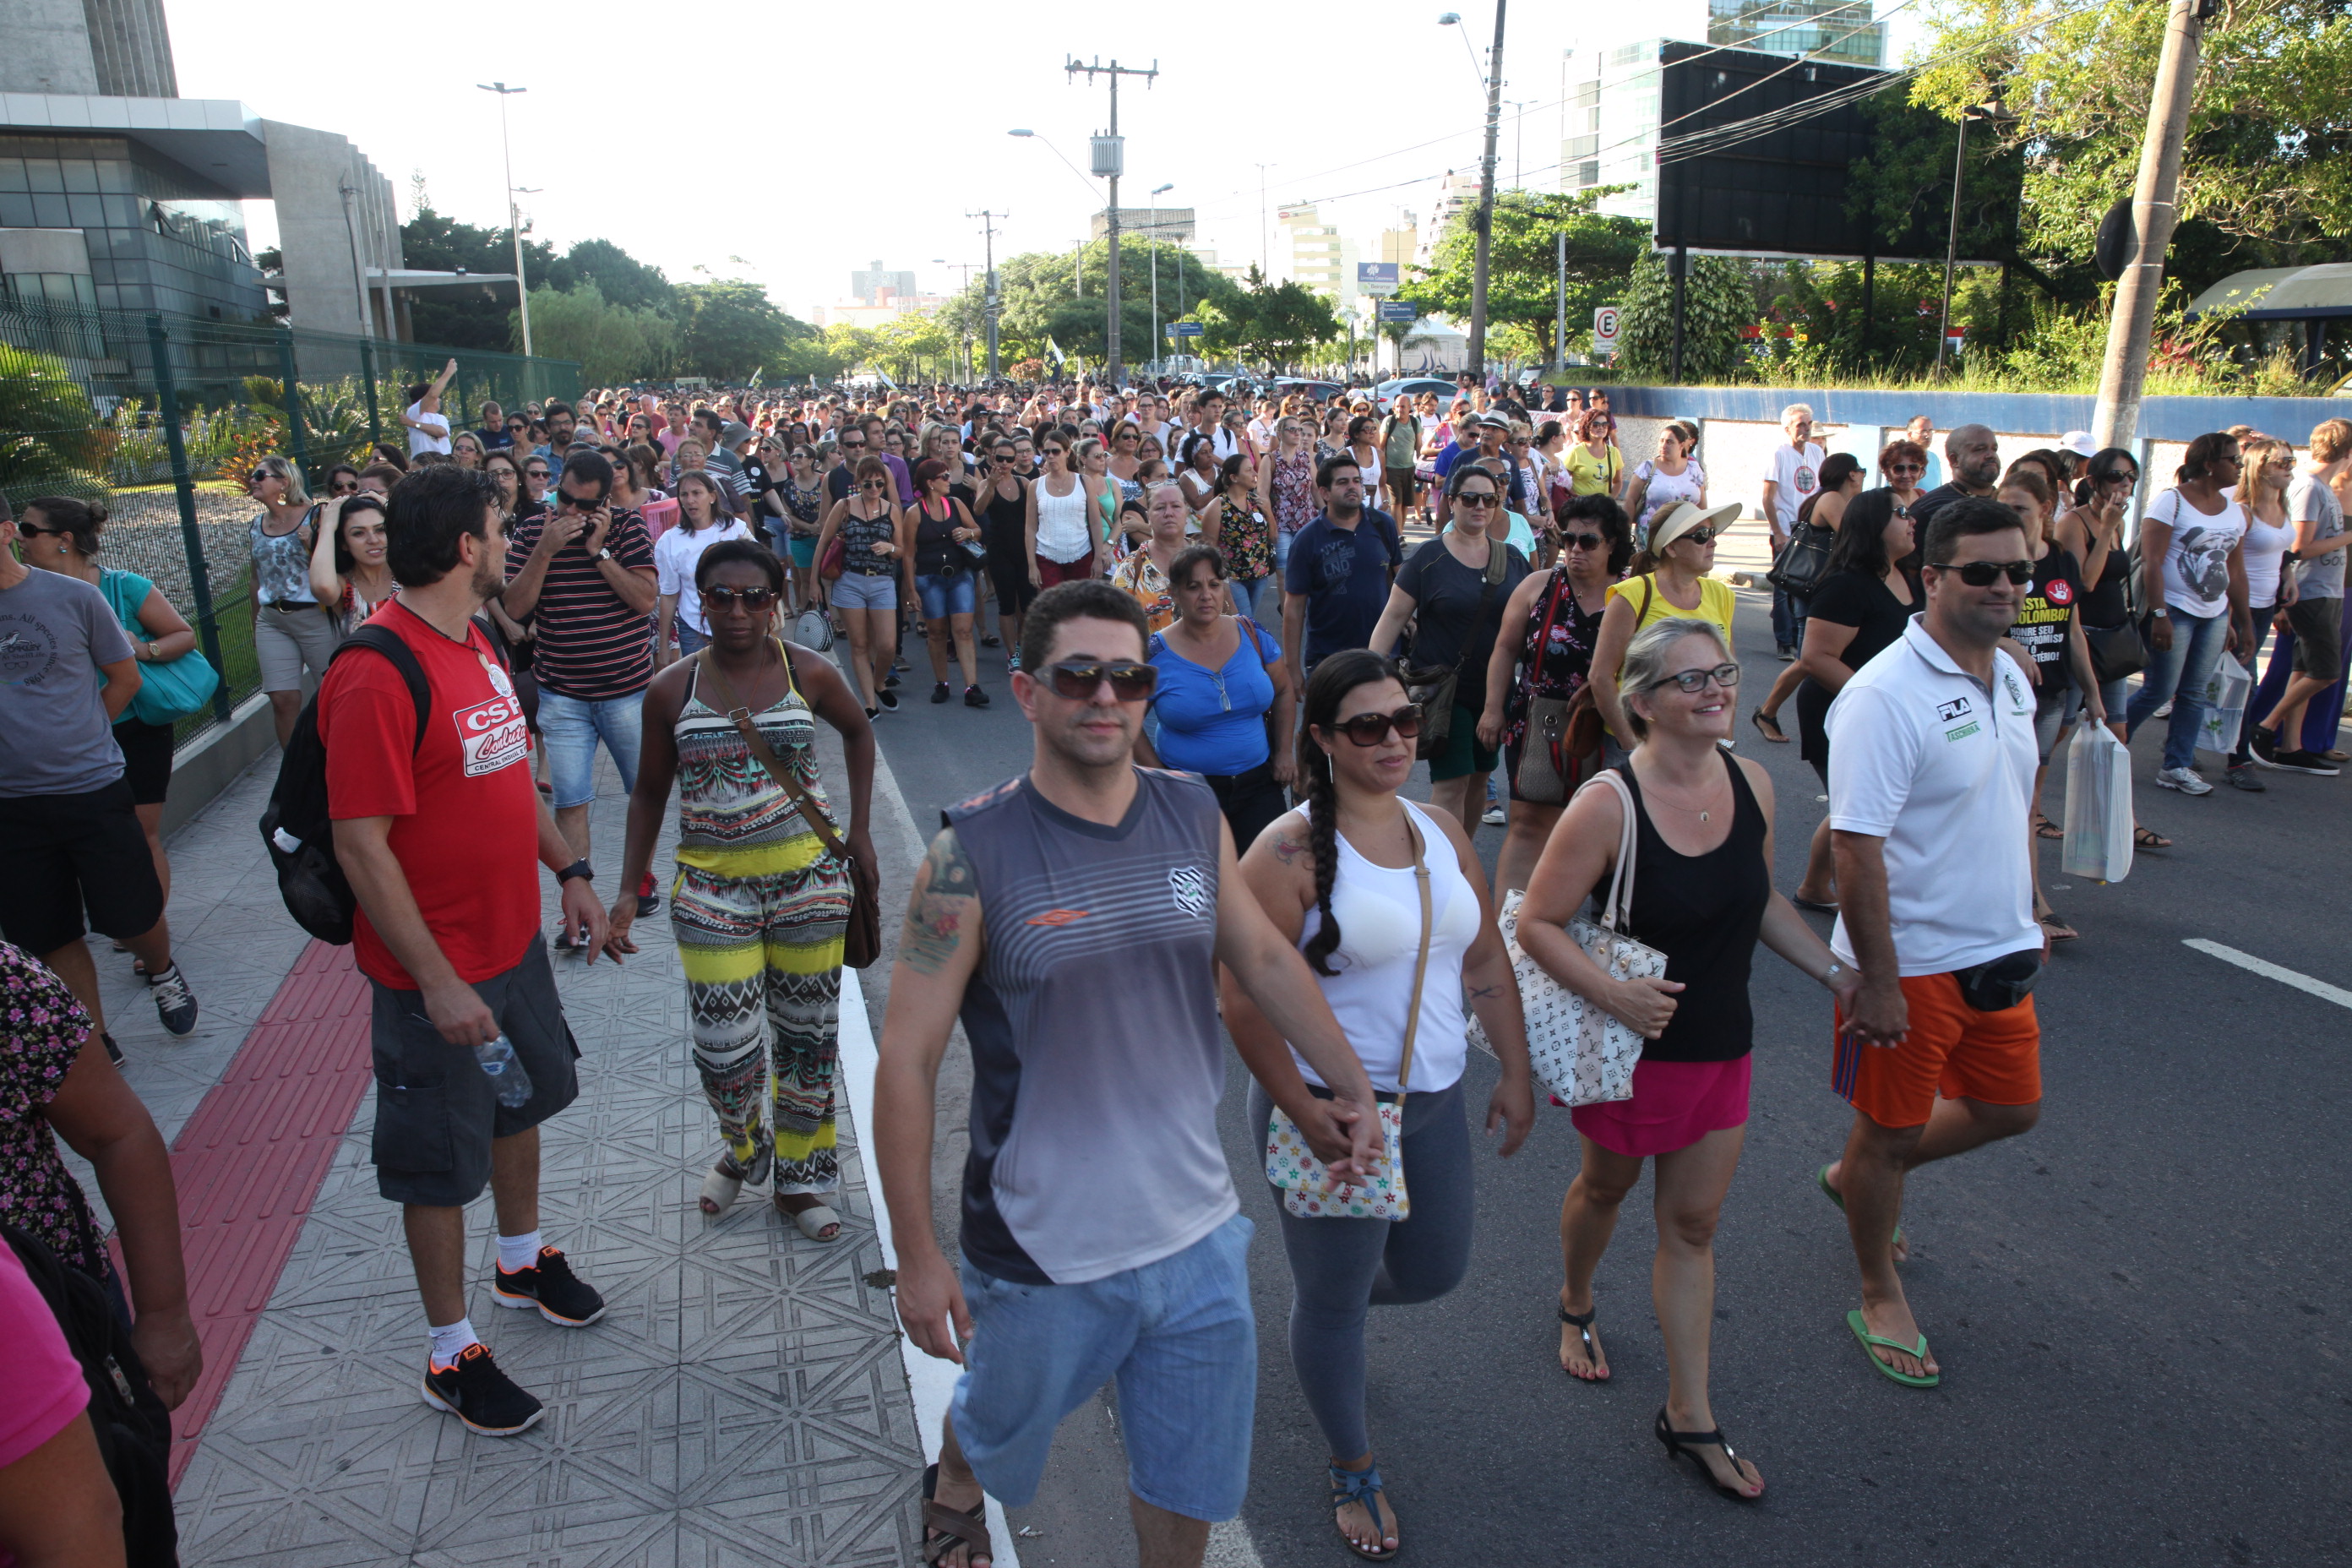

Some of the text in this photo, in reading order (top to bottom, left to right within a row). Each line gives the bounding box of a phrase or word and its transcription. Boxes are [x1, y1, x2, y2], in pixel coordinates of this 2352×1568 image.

[1603, 315, 1613, 332] E
[2022, 597, 2048, 611] STA
[19, 613, 35, 624] All
[2013, 608, 2070, 624] OLOMBO!
[34, 621, 59, 650] species
[2010, 625, 2055, 637] HONRE SEU
[42, 651, 60, 672] since
[2031, 651, 2060, 662] STÉRIO!
[1938, 699, 1971, 721] FILA
[474, 759, 502, 771] CENTRAL
[502, 751, 520, 764] SINDICAL
